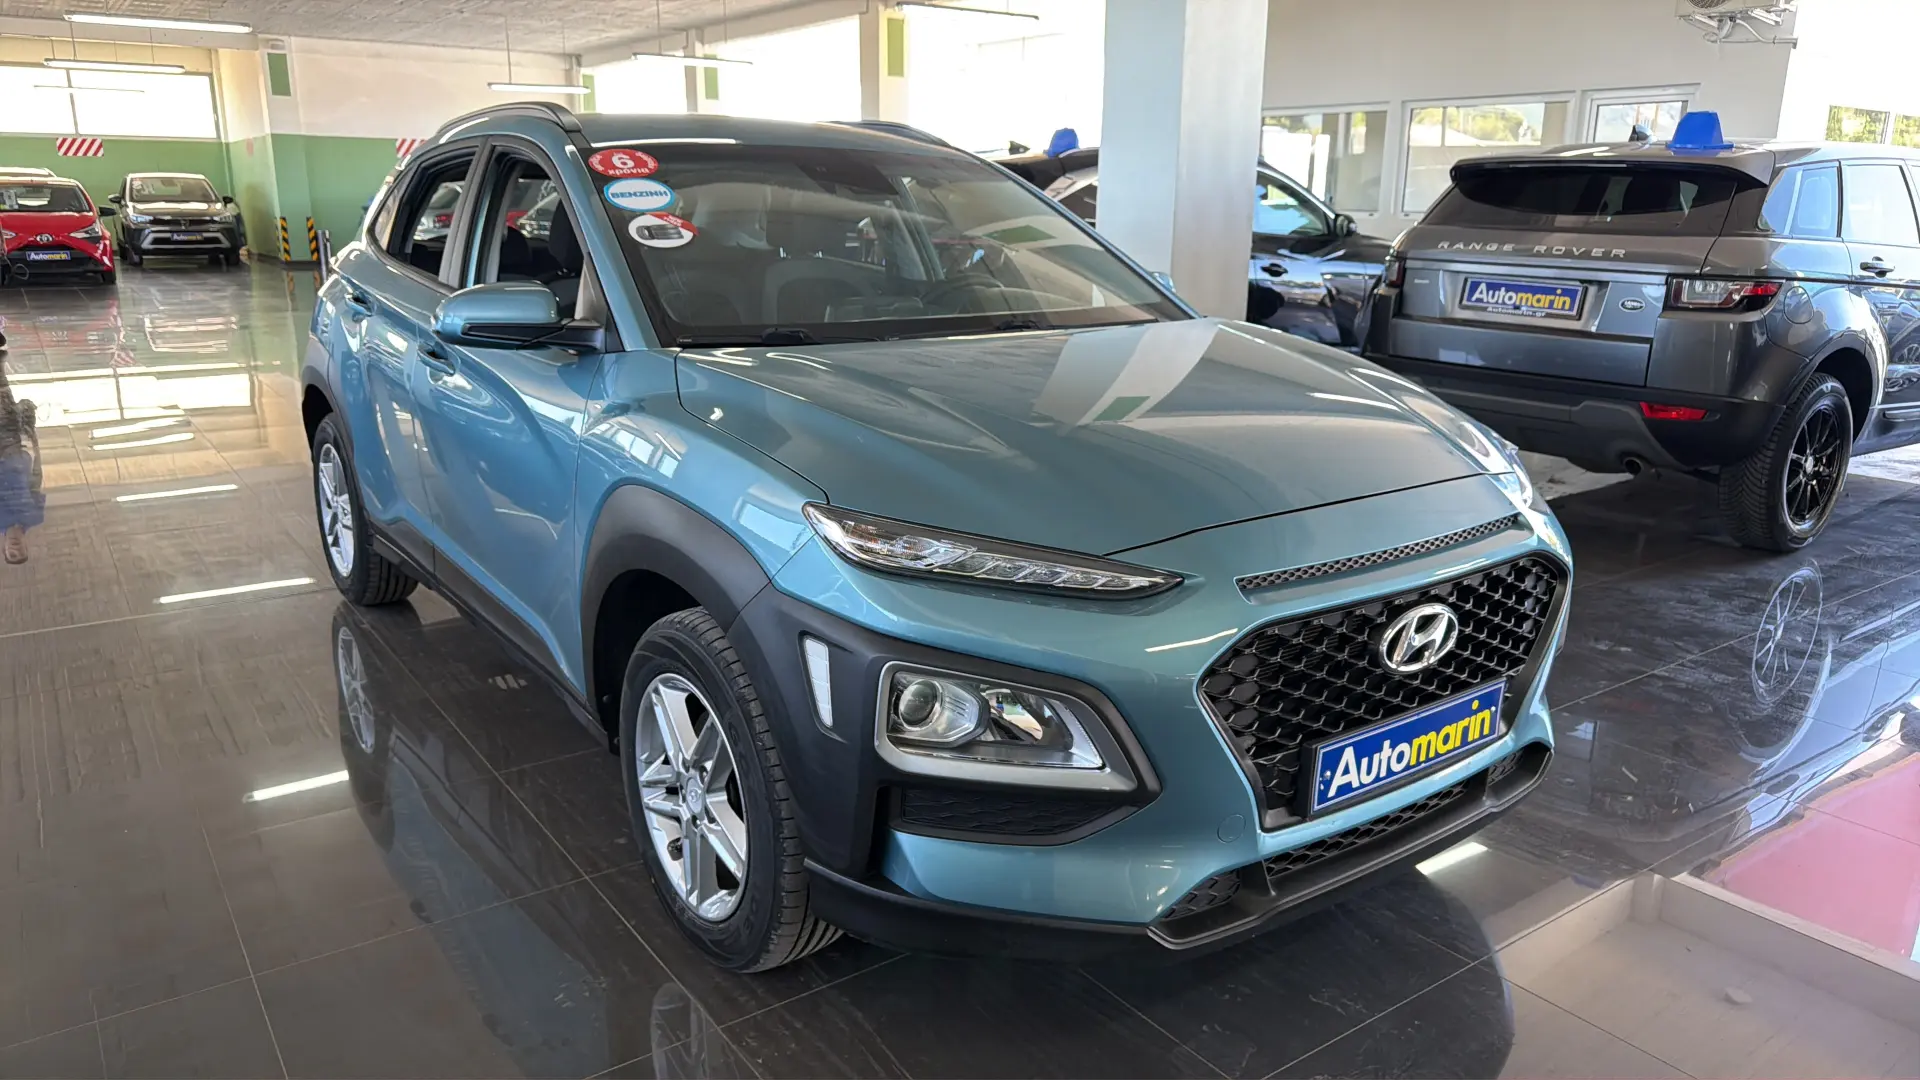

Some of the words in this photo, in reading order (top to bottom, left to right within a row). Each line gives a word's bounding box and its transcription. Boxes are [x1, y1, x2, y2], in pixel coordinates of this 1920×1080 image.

[612, 153, 635, 168] 6
[30, 252, 68, 260] Automarin
[1437, 241, 1516, 251] RANGE
[1533, 245, 1627, 258] ROVER
[1471, 283, 1571, 310] Automarin
[1328, 700, 1491, 797] Automarin
